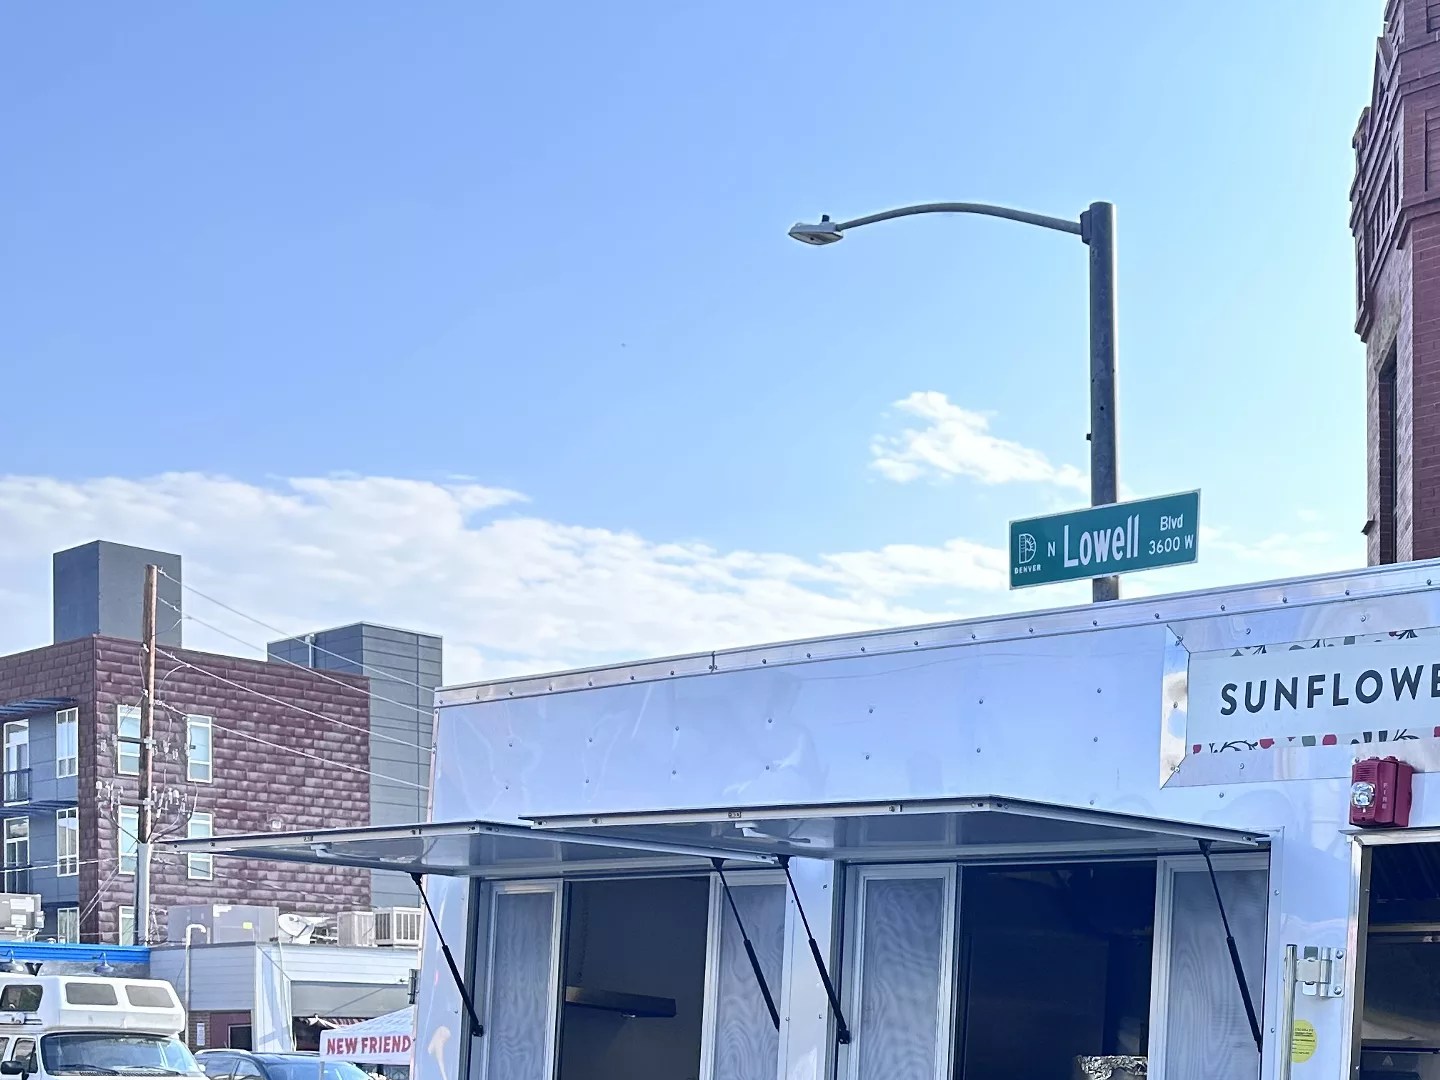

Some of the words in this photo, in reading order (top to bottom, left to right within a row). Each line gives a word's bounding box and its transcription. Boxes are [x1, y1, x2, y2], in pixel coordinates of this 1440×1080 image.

[1047, 541, 1056, 558] N
[1063, 514, 1140, 568] Lowell
[1159, 513, 1184, 532] Blvd
[1148, 536, 1180, 555] 3600
[1184, 534, 1194, 550] W
[1014, 564, 1042, 575] DENVER
[326, 1037, 358, 1055] NEW
